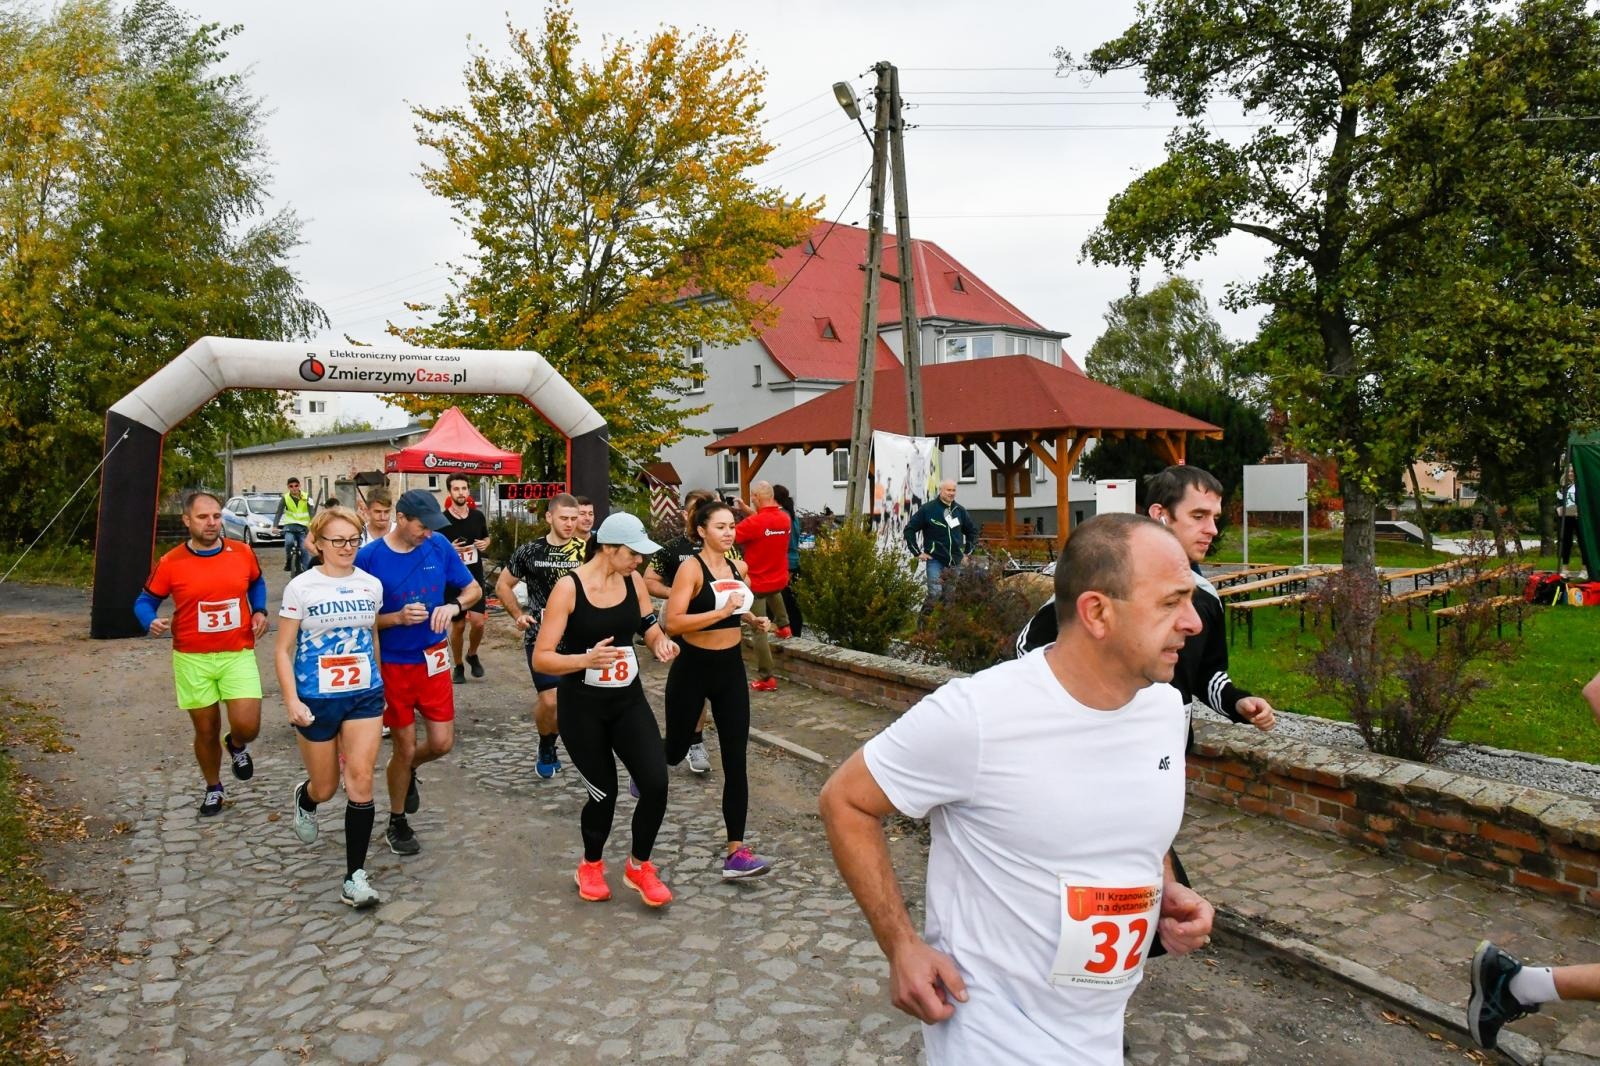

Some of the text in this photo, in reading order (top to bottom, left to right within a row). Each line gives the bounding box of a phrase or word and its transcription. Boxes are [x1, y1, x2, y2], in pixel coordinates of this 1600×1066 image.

[329, 349, 397, 361] Elektroniczny
[328, 365, 467, 385] ZmierzymyCzas.pl
[207, 611, 232, 628] 31
[330, 666, 361, 687] 22
[599, 661, 629, 682] 18
[1095, 892, 1105, 901] III
[1108, 888, 1155, 901] Krzanowicki
[1097, 904, 1110, 912] na
[1112, 901, 1149, 913] dystansie
[1084, 918, 1148, 974] 32
